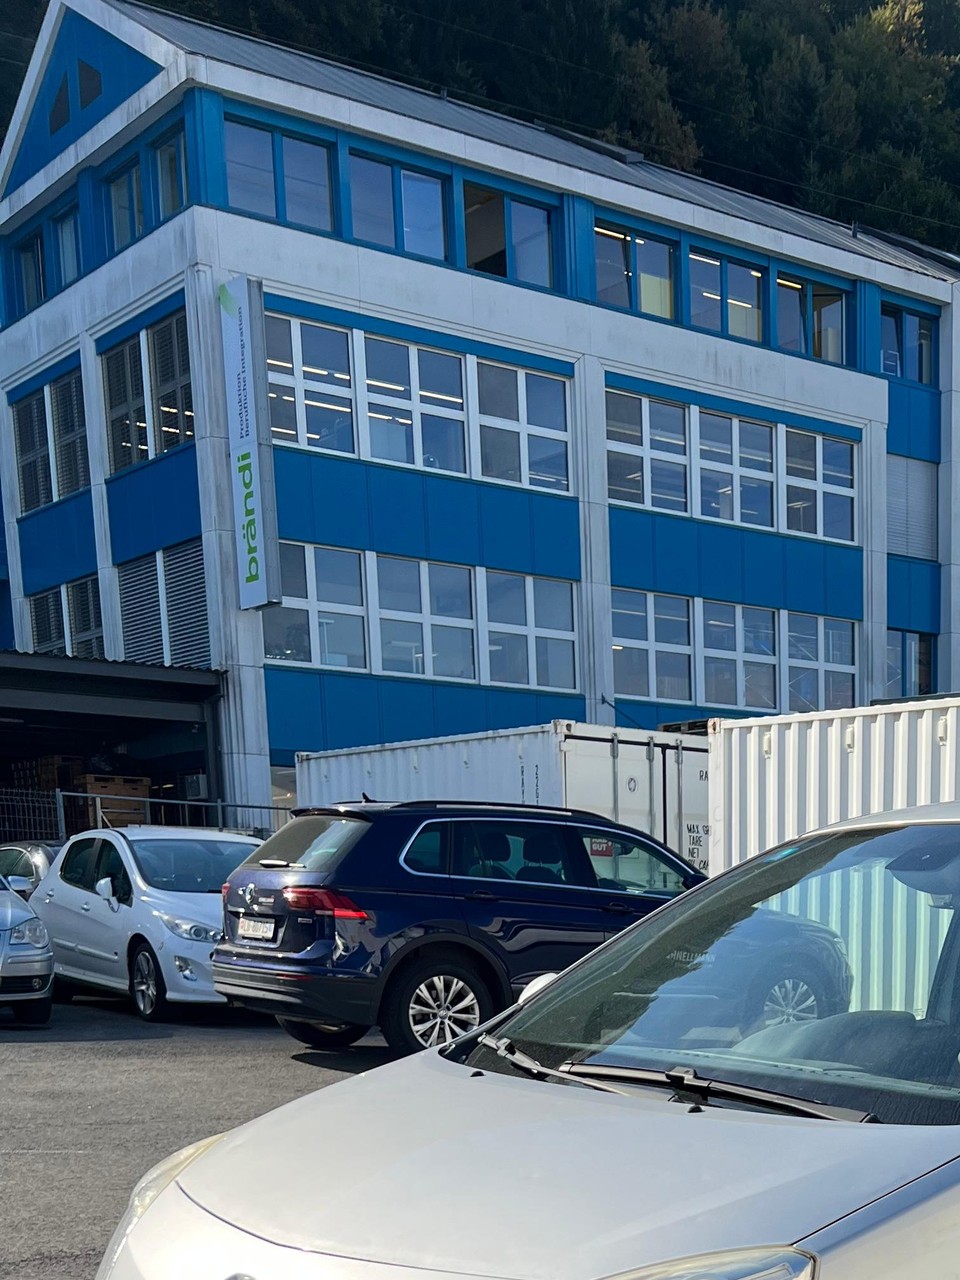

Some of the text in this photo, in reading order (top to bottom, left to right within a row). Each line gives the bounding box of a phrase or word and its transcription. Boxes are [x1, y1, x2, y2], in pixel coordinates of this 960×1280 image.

[238, 306, 246, 374] Integration
[237, 372, 245, 439] Produktion
[237, 451, 260, 583] brändi
